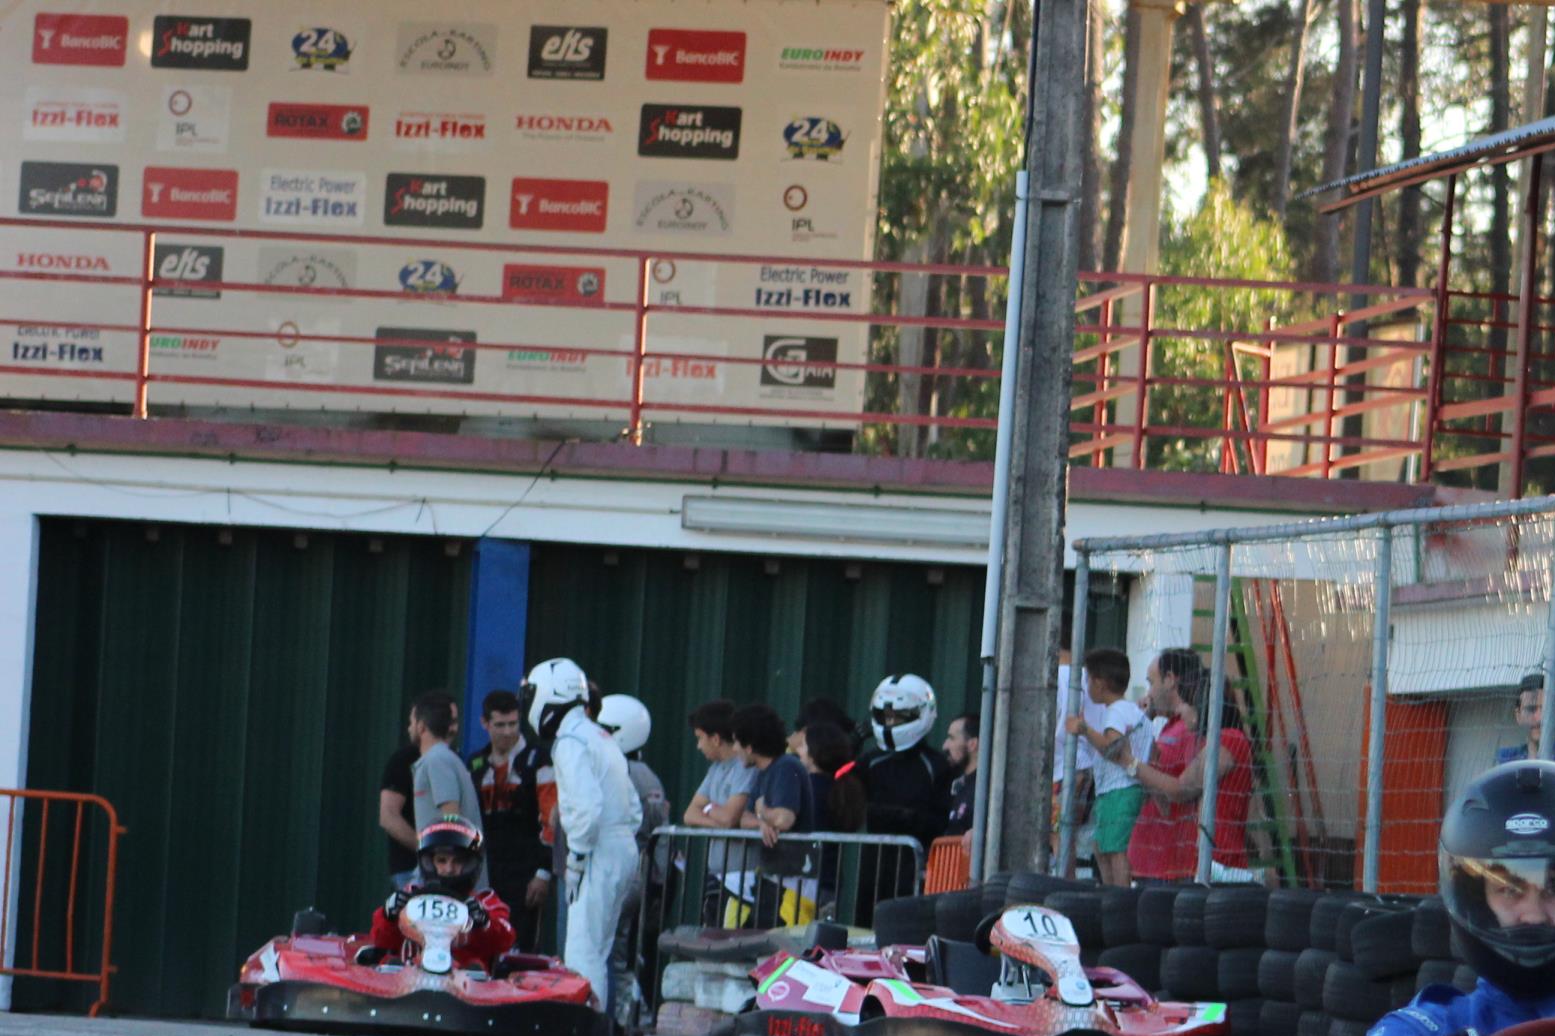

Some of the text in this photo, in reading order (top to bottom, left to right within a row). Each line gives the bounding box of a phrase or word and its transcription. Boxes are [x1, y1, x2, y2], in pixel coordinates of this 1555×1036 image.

[60, 34, 121, 51] BancoBIC
[158, 27, 244, 60] Shopping
[300, 30, 337, 53] 24
[675, 49, 740, 67] BancoBIC
[780, 47, 865, 62] EUROINDY
[273, 114, 329, 130] ROTAX
[515, 114, 613, 133] HONDA
[665, 110, 703, 127] Kart
[644, 117, 733, 149] Shopping
[792, 120, 830, 143] 24
[271, 175, 356, 194] Electric Power
[170, 188, 231, 205] BancoBIC
[391, 186, 478, 219] Shopping
[538, 198, 602, 217] BancoBIC
[17, 253, 111, 272] HONDA
[406, 262, 444, 287] 24
[509, 275, 566, 291] ROTAX
[760, 266, 849, 285] Electric Power
[756, 288, 851, 308] Izzi-Flex
[13, 342, 104, 362] Izzi-Flex
[150, 335, 220, 352] UROINDY
[626, 354, 716, 379] Izi-Flex
[418, 900, 459, 920] 158
[1023, 912, 1058, 938] 10
